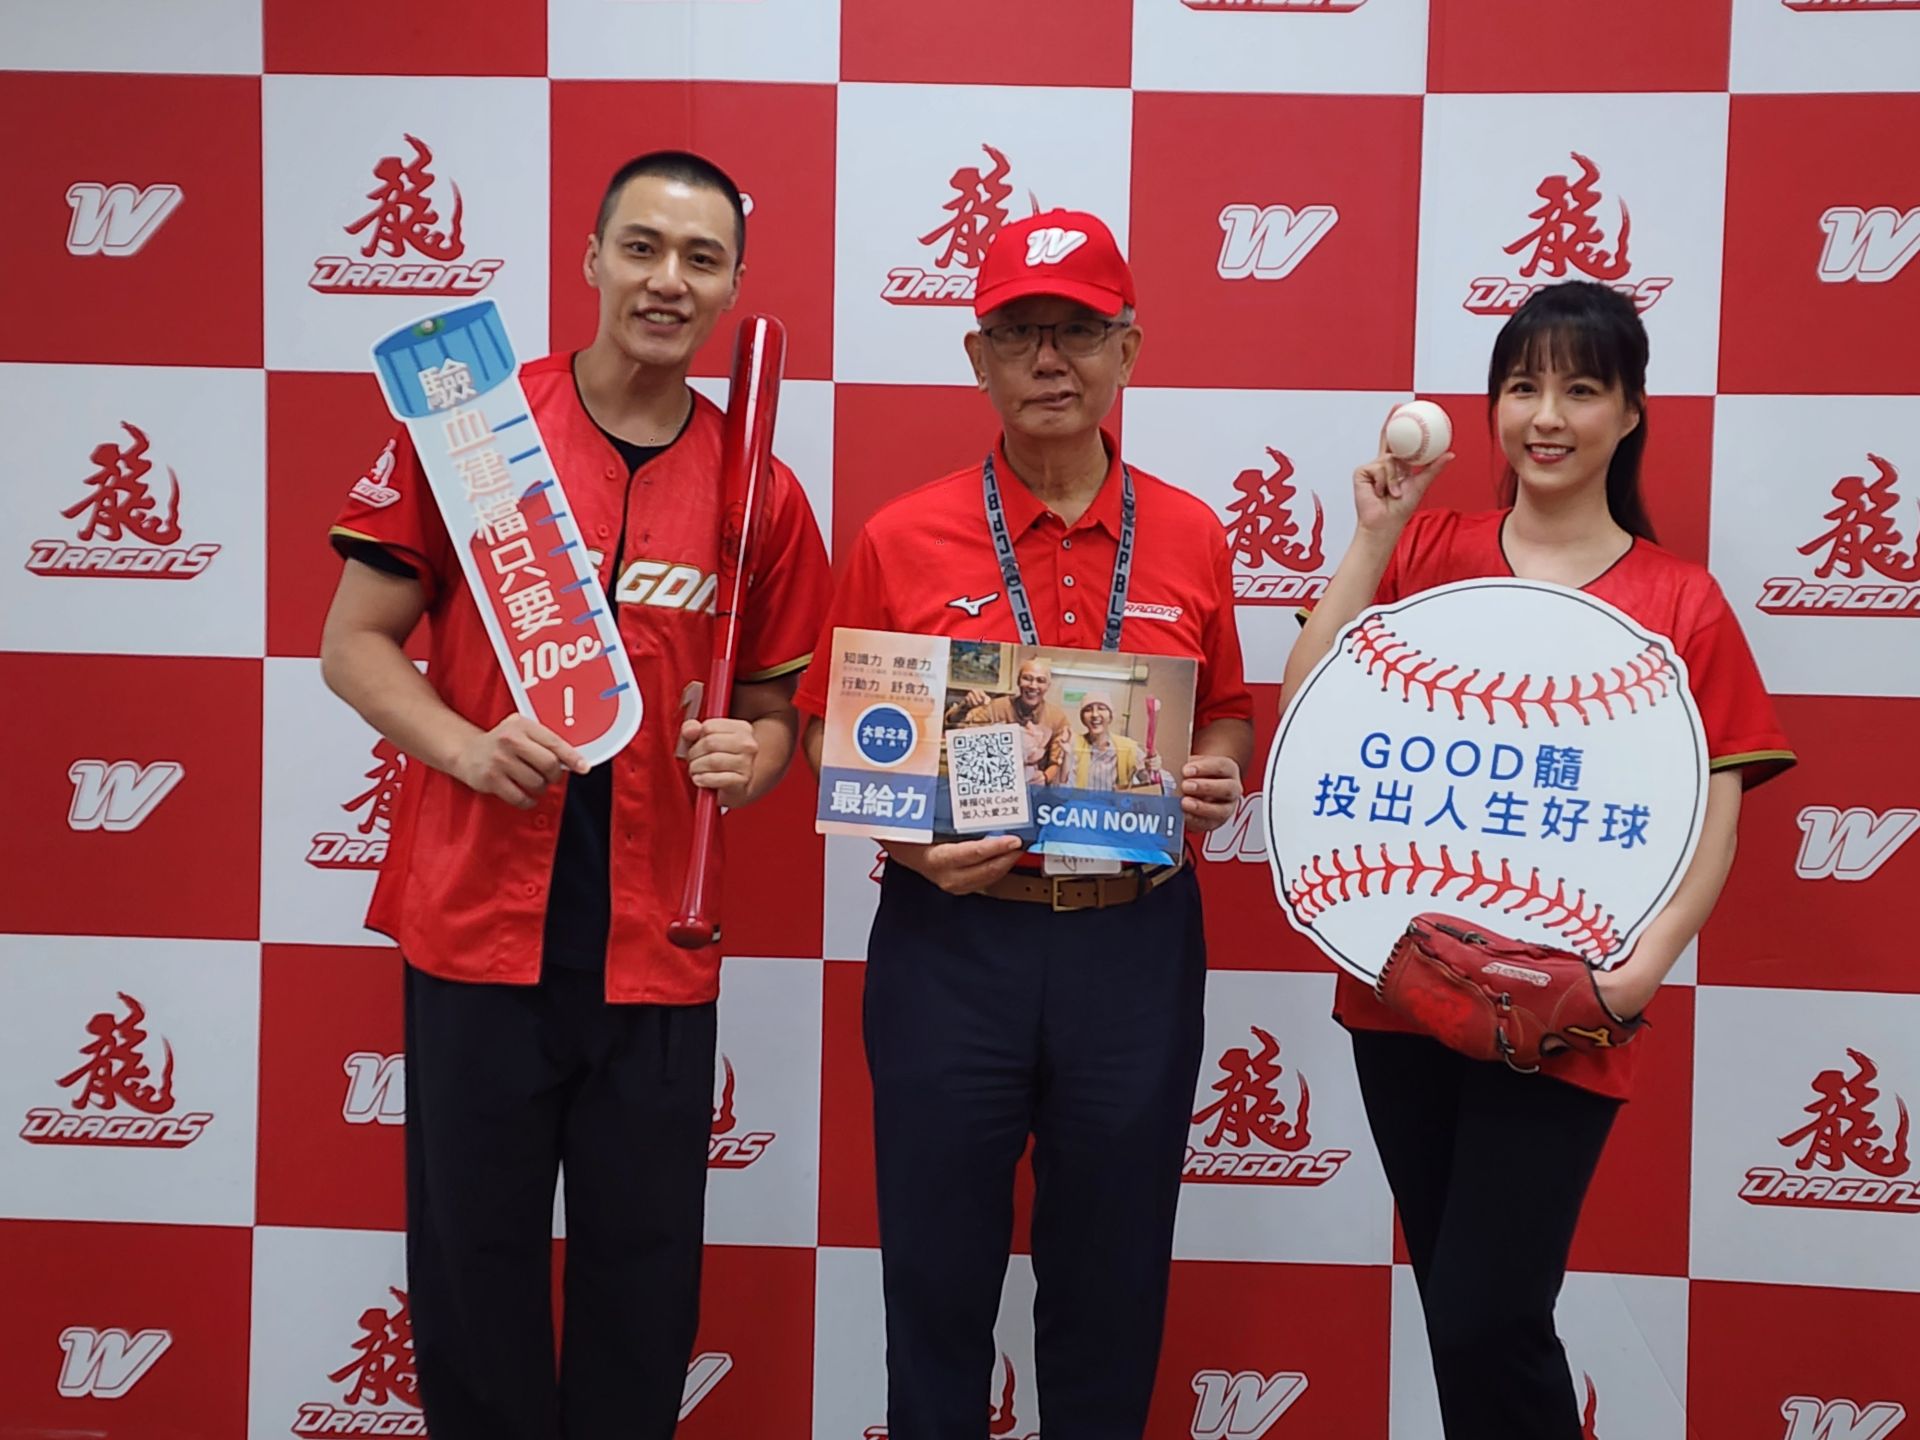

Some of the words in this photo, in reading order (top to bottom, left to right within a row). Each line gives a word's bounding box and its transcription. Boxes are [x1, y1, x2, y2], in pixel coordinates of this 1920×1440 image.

[65, 181, 185, 256] W
[343, 132, 465, 262] 龍
[1502, 150, 1632, 281] 龍
[308, 256, 505, 297] DRAGONS
[1024, 227, 1088, 267] W
[1216, 203, 1339, 280] W
[1817, 205, 1920, 284] W
[59, 420, 182, 546] 龍
[24, 540, 222, 580] DRAGONS
[67, 759, 186, 833] W
[1359, 731, 1584, 792] GOOD髓
[830, 780, 927, 821] 最給力
[1036, 804, 1097, 829] SCAN
[1103, 810, 1160, 835] NOW
[1166, 815, 1175, 837] !
[1312, 773, 1652, 850] 投出人生好球
[1795, 805, 1920, 882] W
[55, 991, 176, 1114] 龍
[1191, 1025, 1312, 1152] 龍
[19, 1107, 214, 1149] DRAGONS
[1777, 1047, 1911, 1178] 龍
[57, 1326, 173, 1399] W
[1190, 1369, 1308, 1440] W
